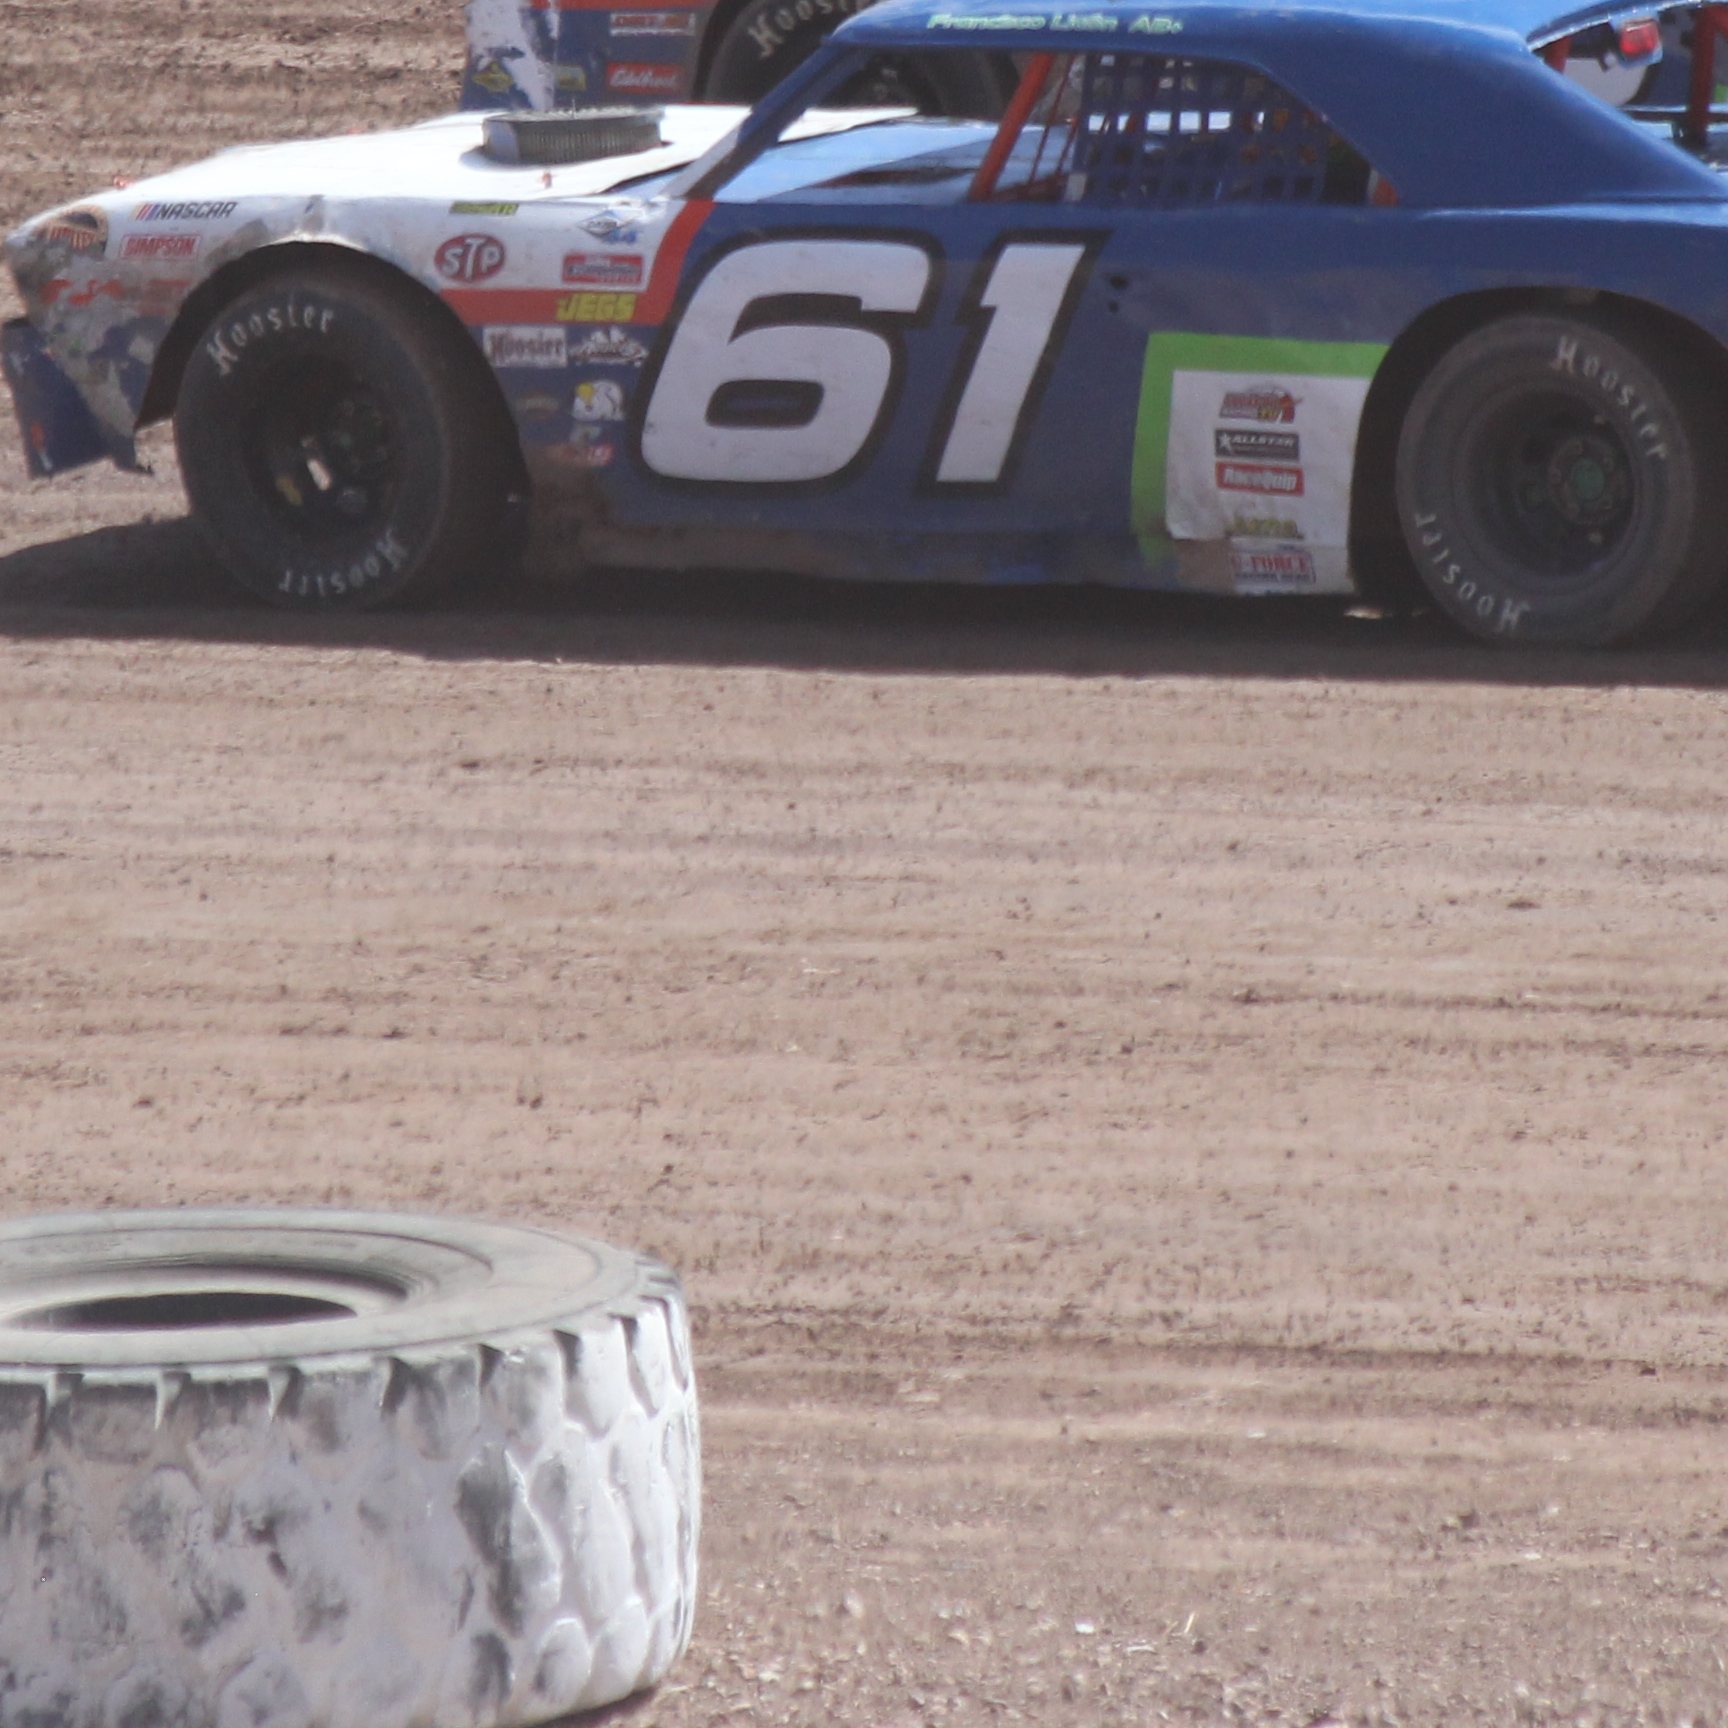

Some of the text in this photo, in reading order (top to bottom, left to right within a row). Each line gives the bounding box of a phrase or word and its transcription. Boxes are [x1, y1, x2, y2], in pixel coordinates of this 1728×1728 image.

[155, 201, 238, 220] NASCAR
[124, 238, 197, 257] SIMPSON
[440, 236, 504, 280] STP
[556, 293, 637, 322] JEGS
[206, 303, 336, 377] Hoosier
[641, 238, 1086, 483] 61
[1549, 335, 1668, 460] Hoosier
[1229, 434, 1295, 448] ALLSTAR
[1224, 466, 1298, 491] RaceQuip
[1413, 512, 1531, 632] Hoosier
